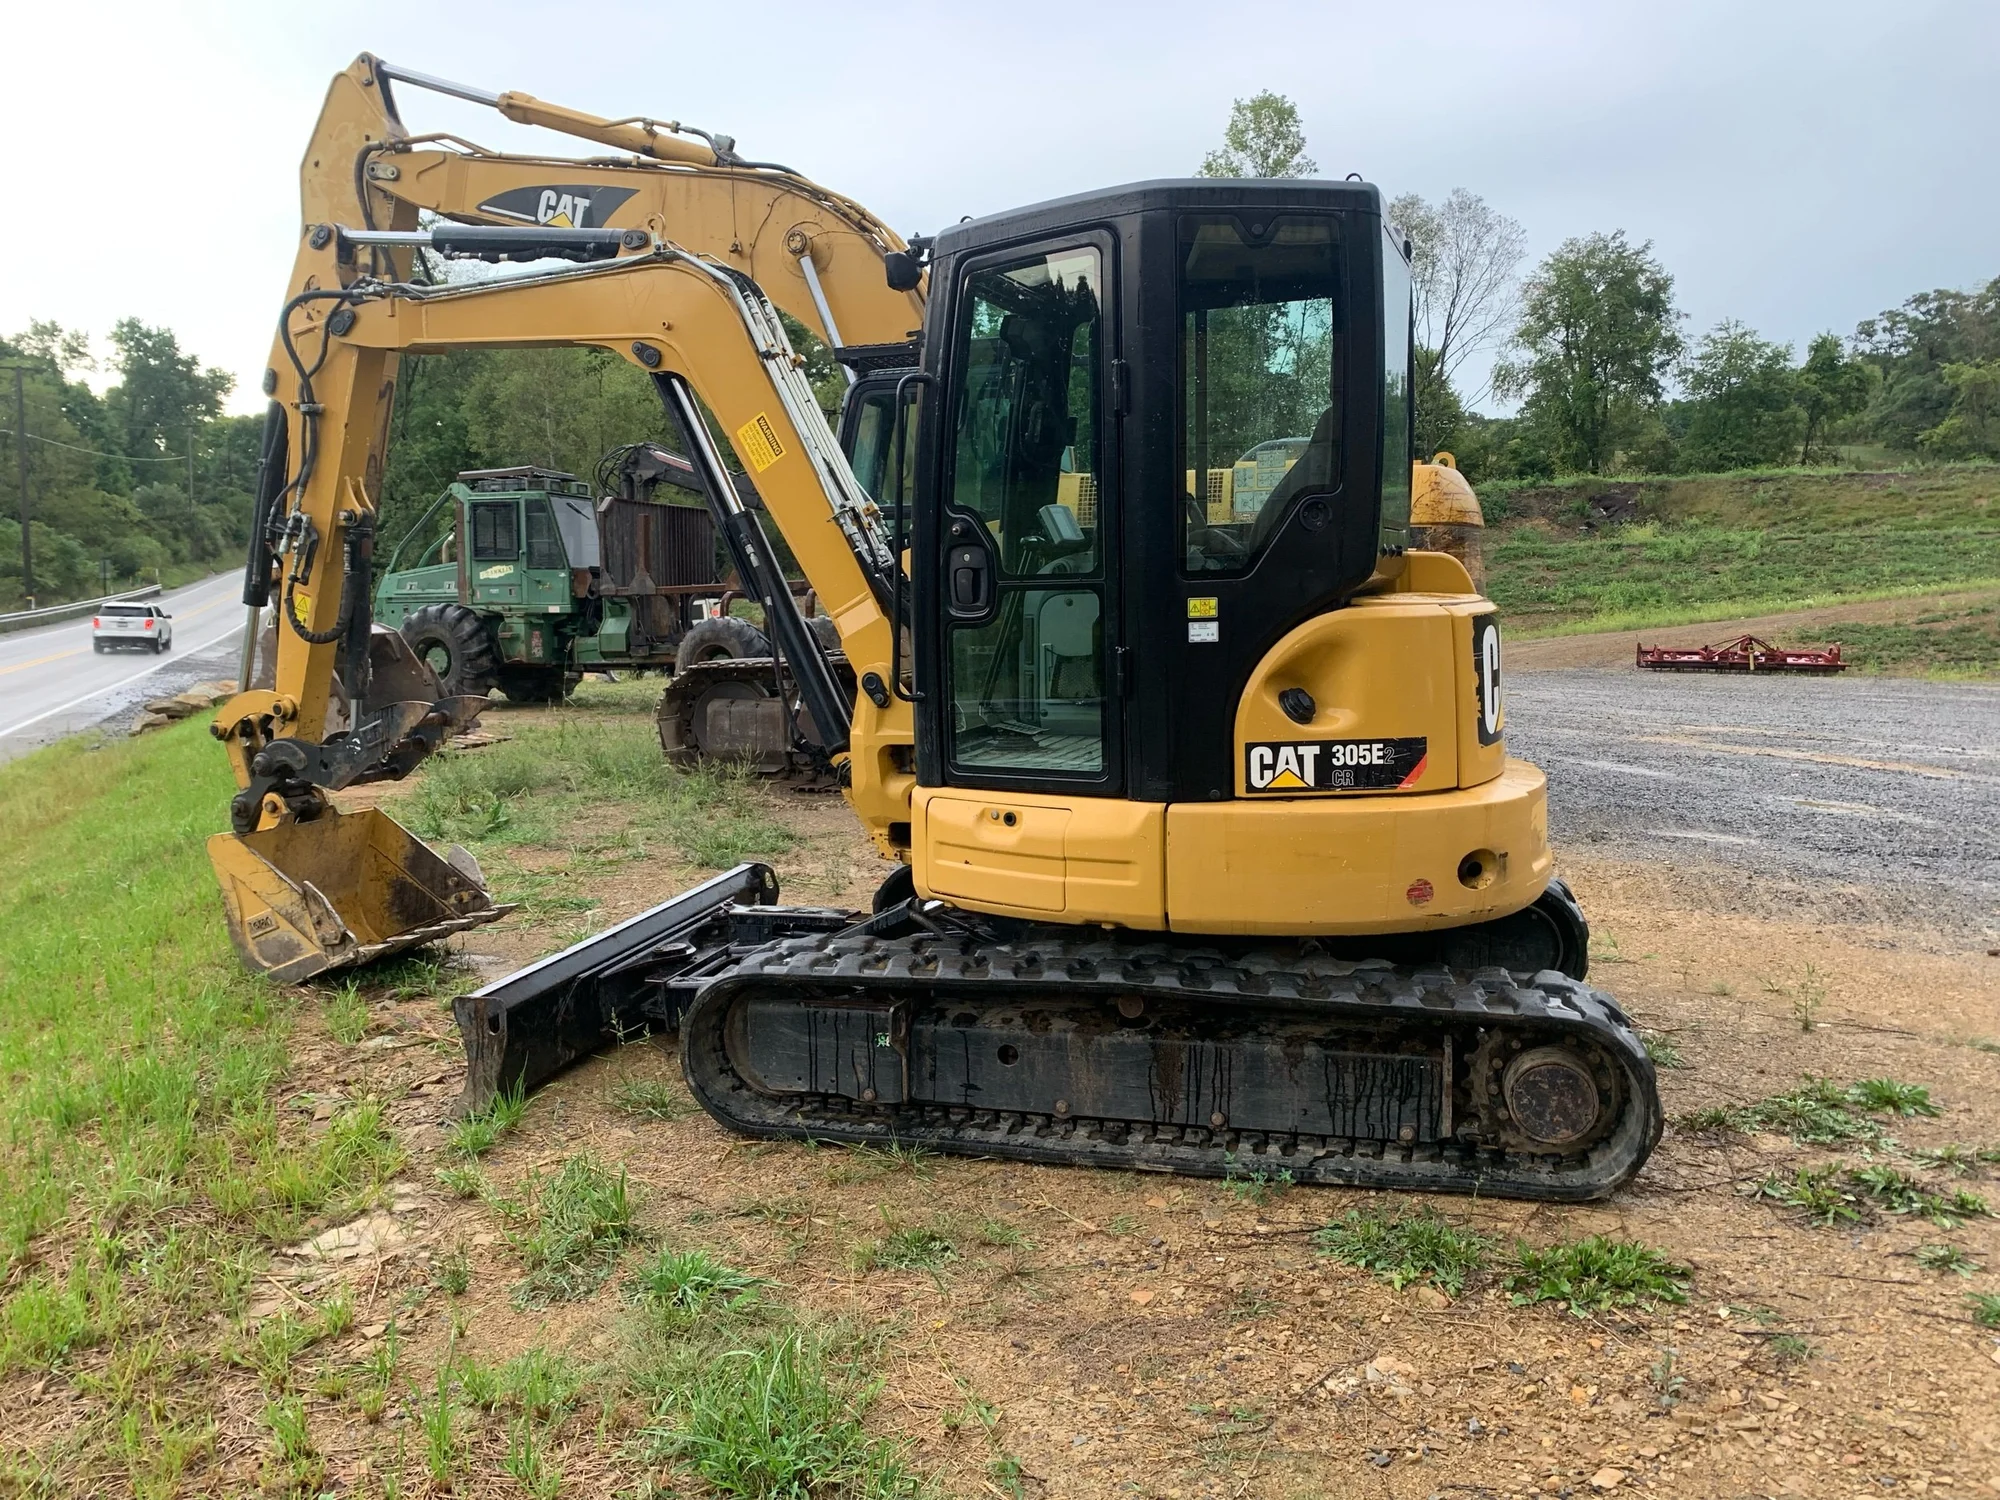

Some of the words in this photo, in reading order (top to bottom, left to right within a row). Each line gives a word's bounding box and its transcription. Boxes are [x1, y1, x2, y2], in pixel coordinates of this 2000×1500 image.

[537, 189, 590, 228] CAT
[758, 417, 782, 456] WARNING
[1250, 745, 1320, 788] CAT
[1331, 769, 1355, 787] CR
